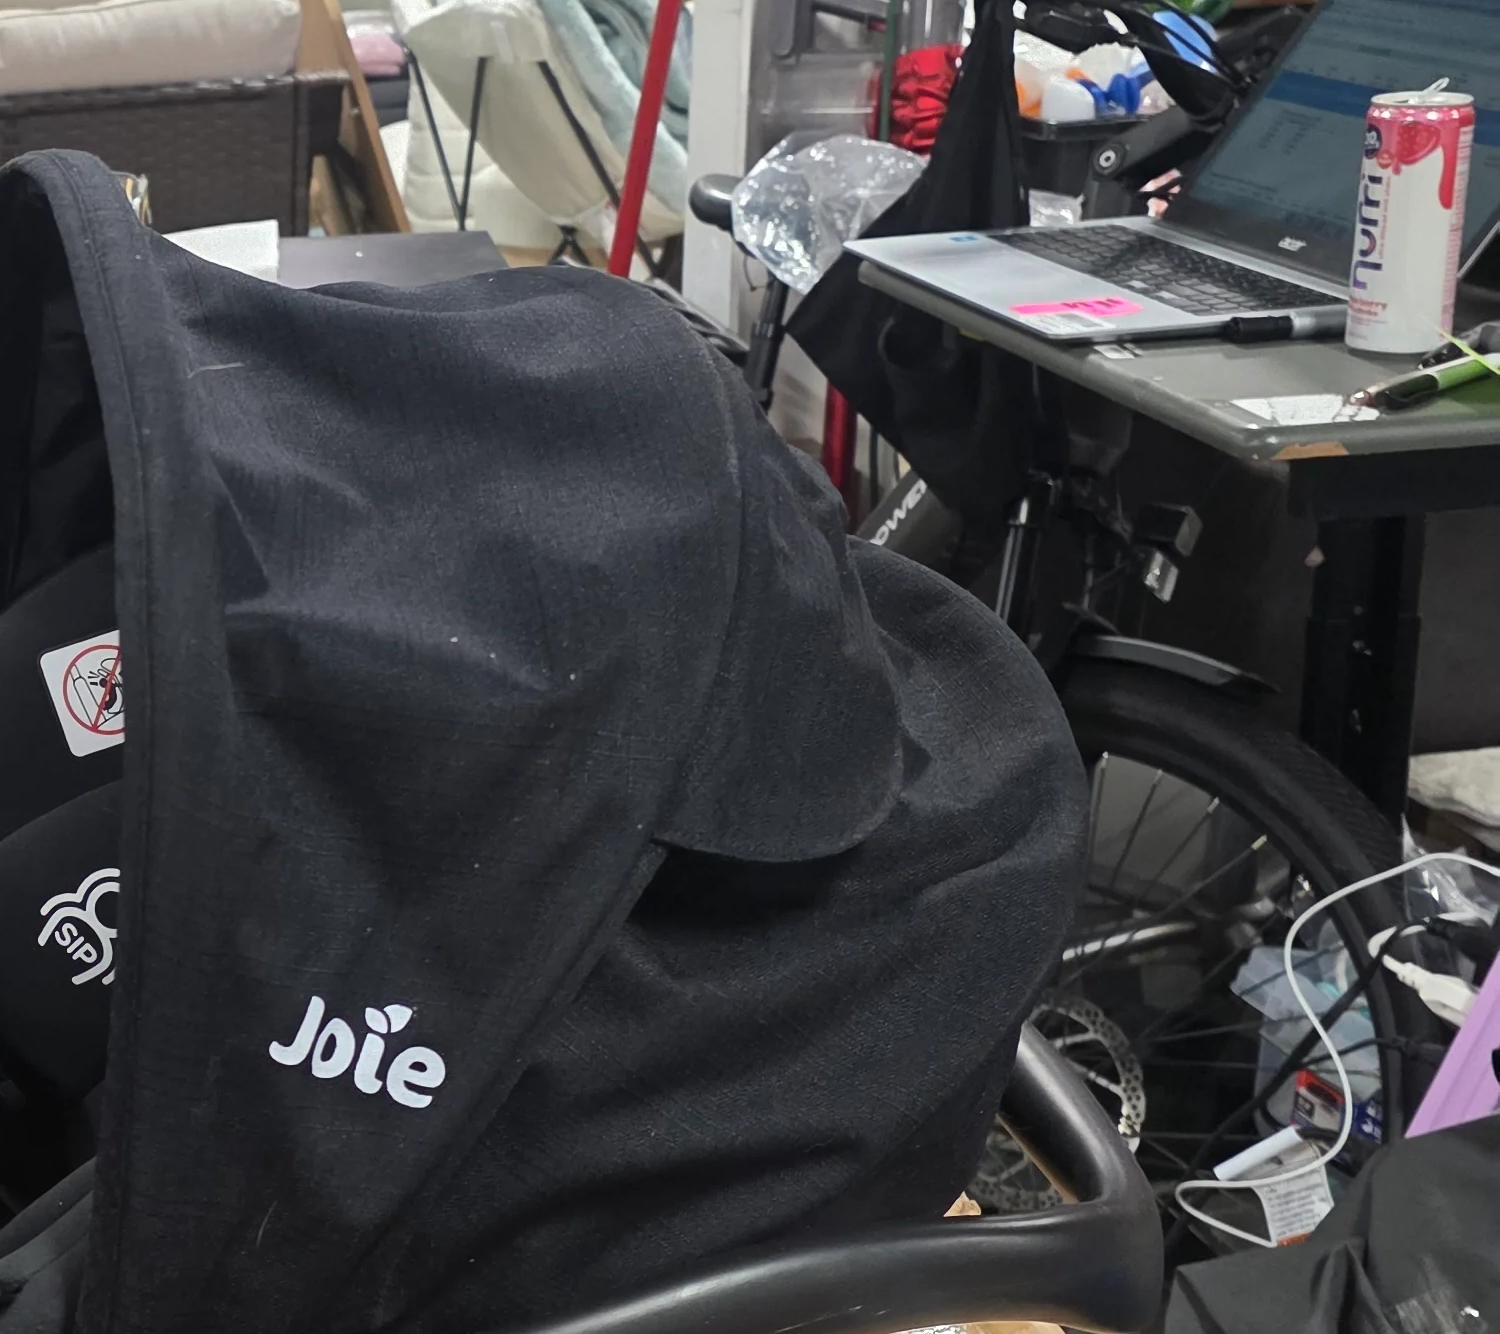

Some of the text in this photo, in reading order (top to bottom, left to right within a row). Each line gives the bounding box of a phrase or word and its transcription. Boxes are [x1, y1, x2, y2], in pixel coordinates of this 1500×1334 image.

[1352, 174, 1383, 291] nurri
[54, 922, 98, 964] SIP
[269, 996, 447, 1110] Joie
